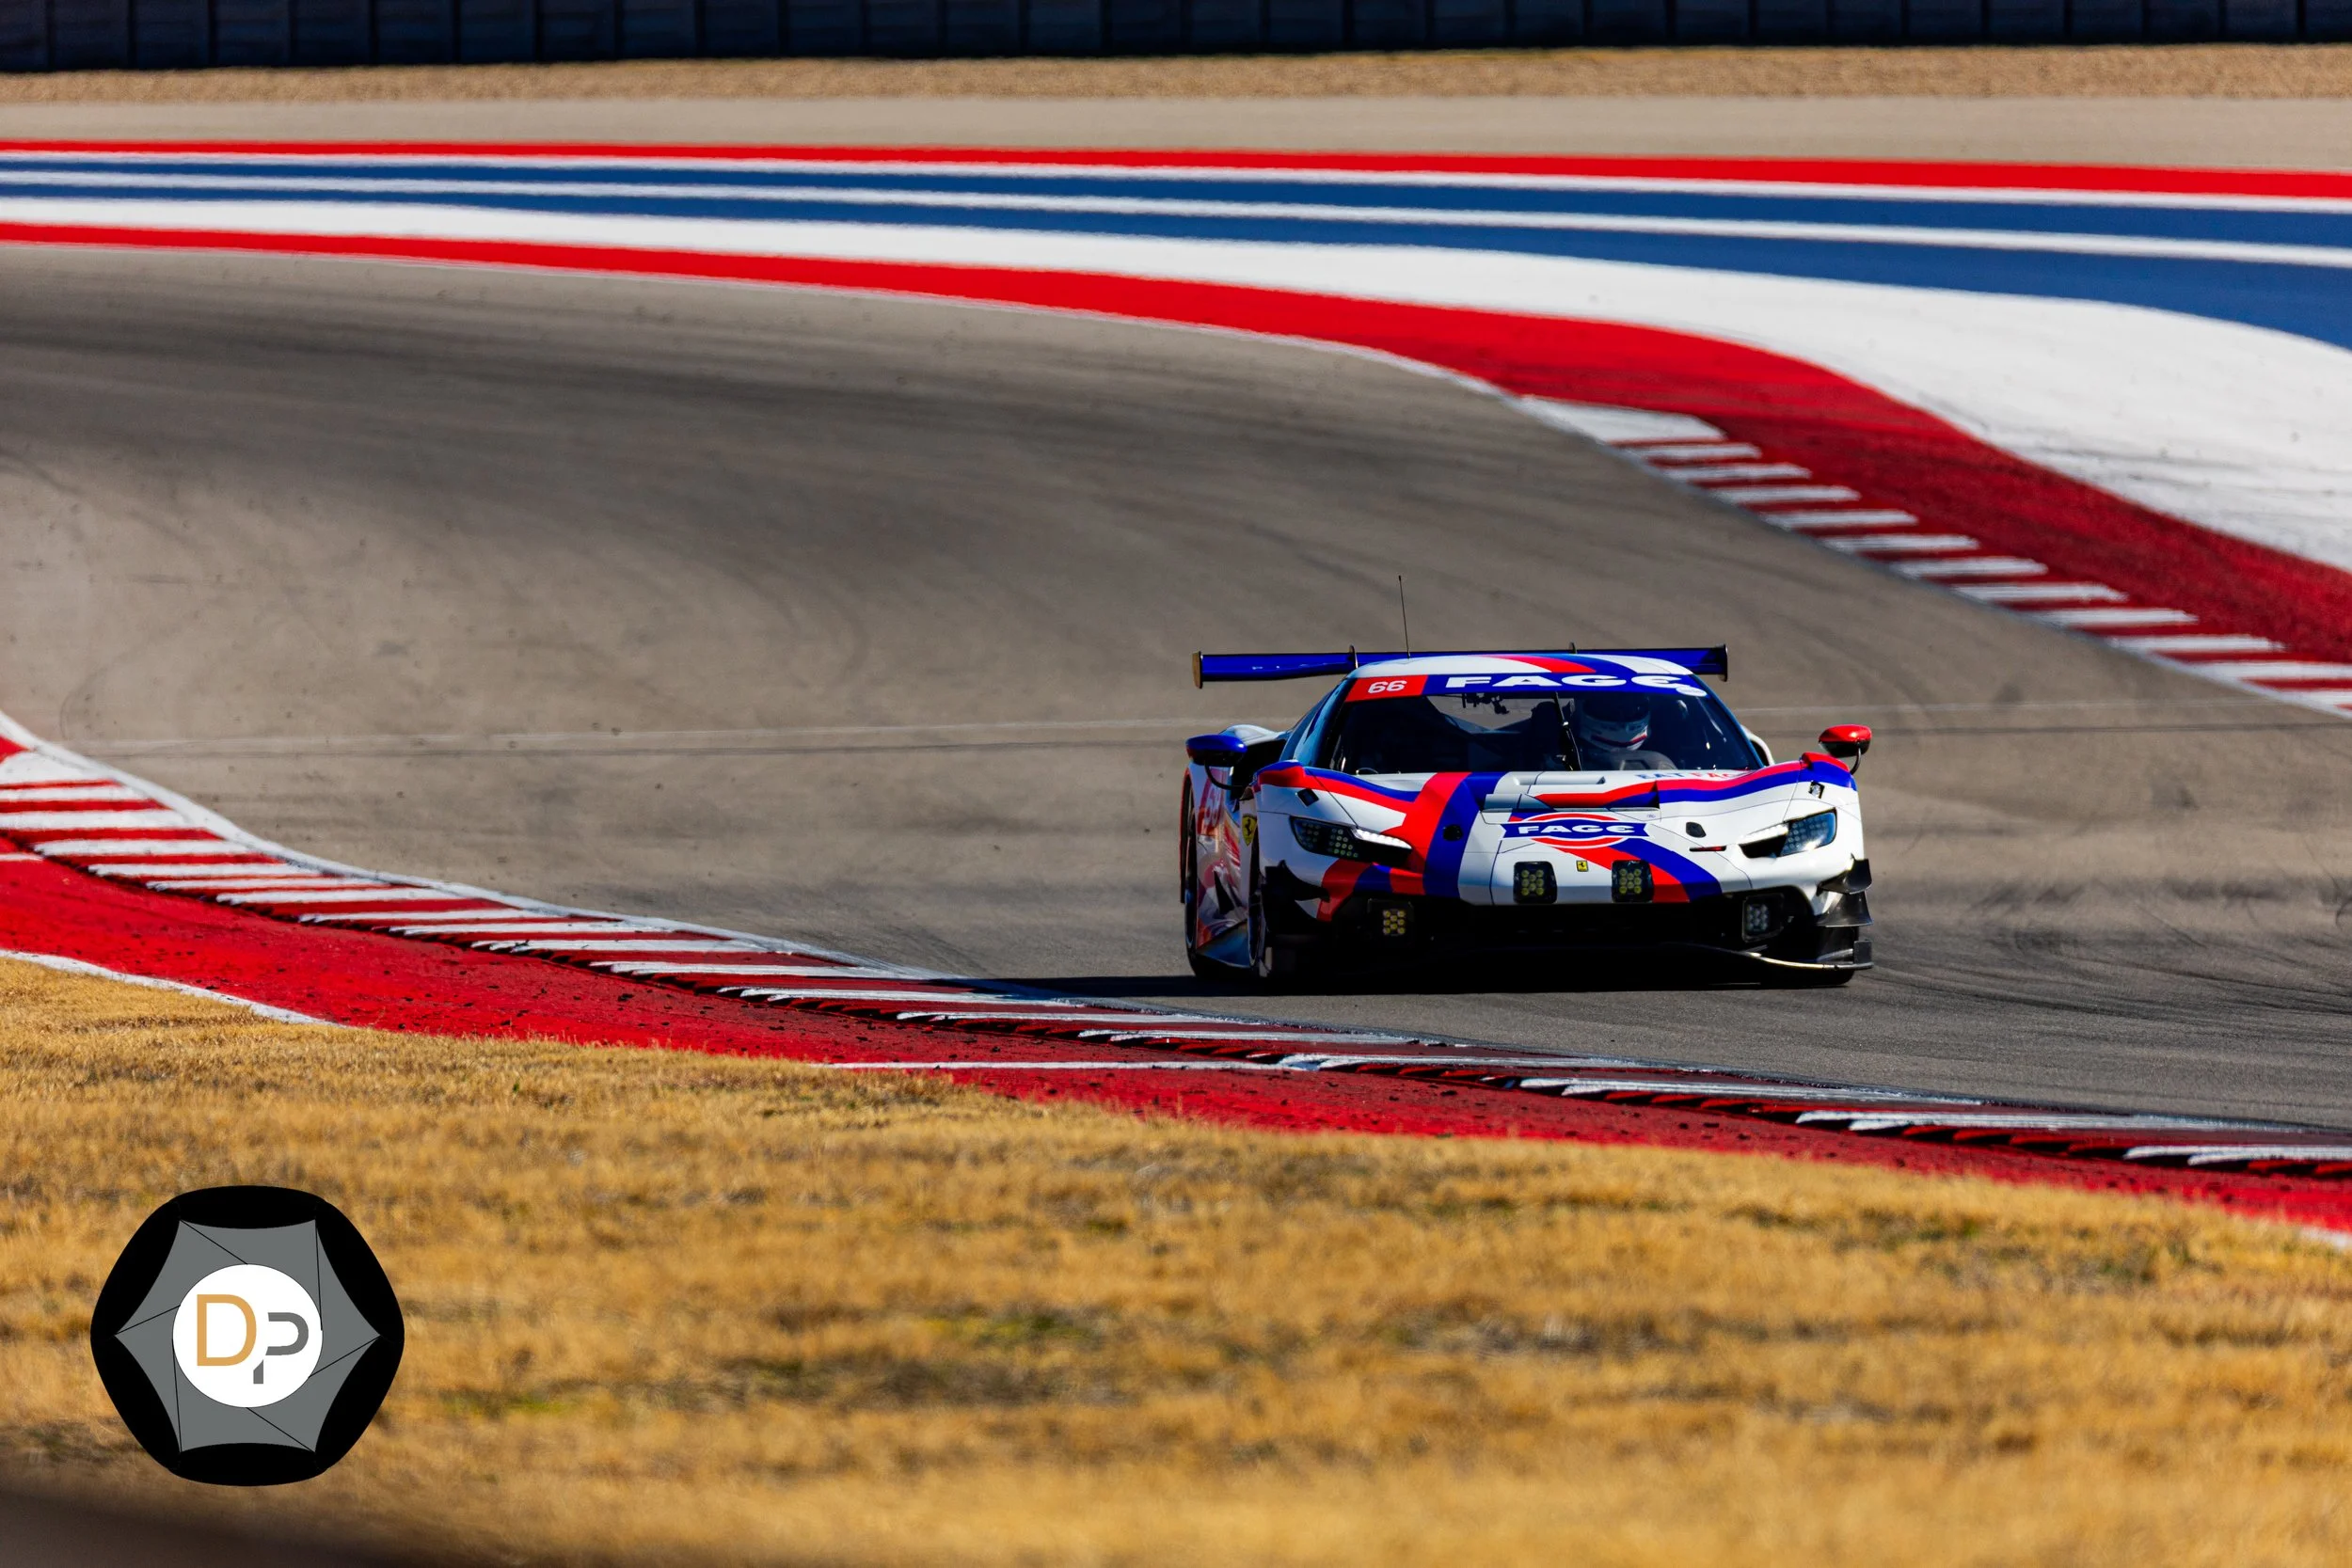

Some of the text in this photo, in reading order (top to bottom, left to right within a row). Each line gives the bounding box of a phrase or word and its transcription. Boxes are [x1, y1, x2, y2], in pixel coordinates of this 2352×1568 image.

[1367, 680, 1407, 694] 66
[1445, 674, 1692, 689] FAGE
[1518, 824, 1635, 834] FAGE
